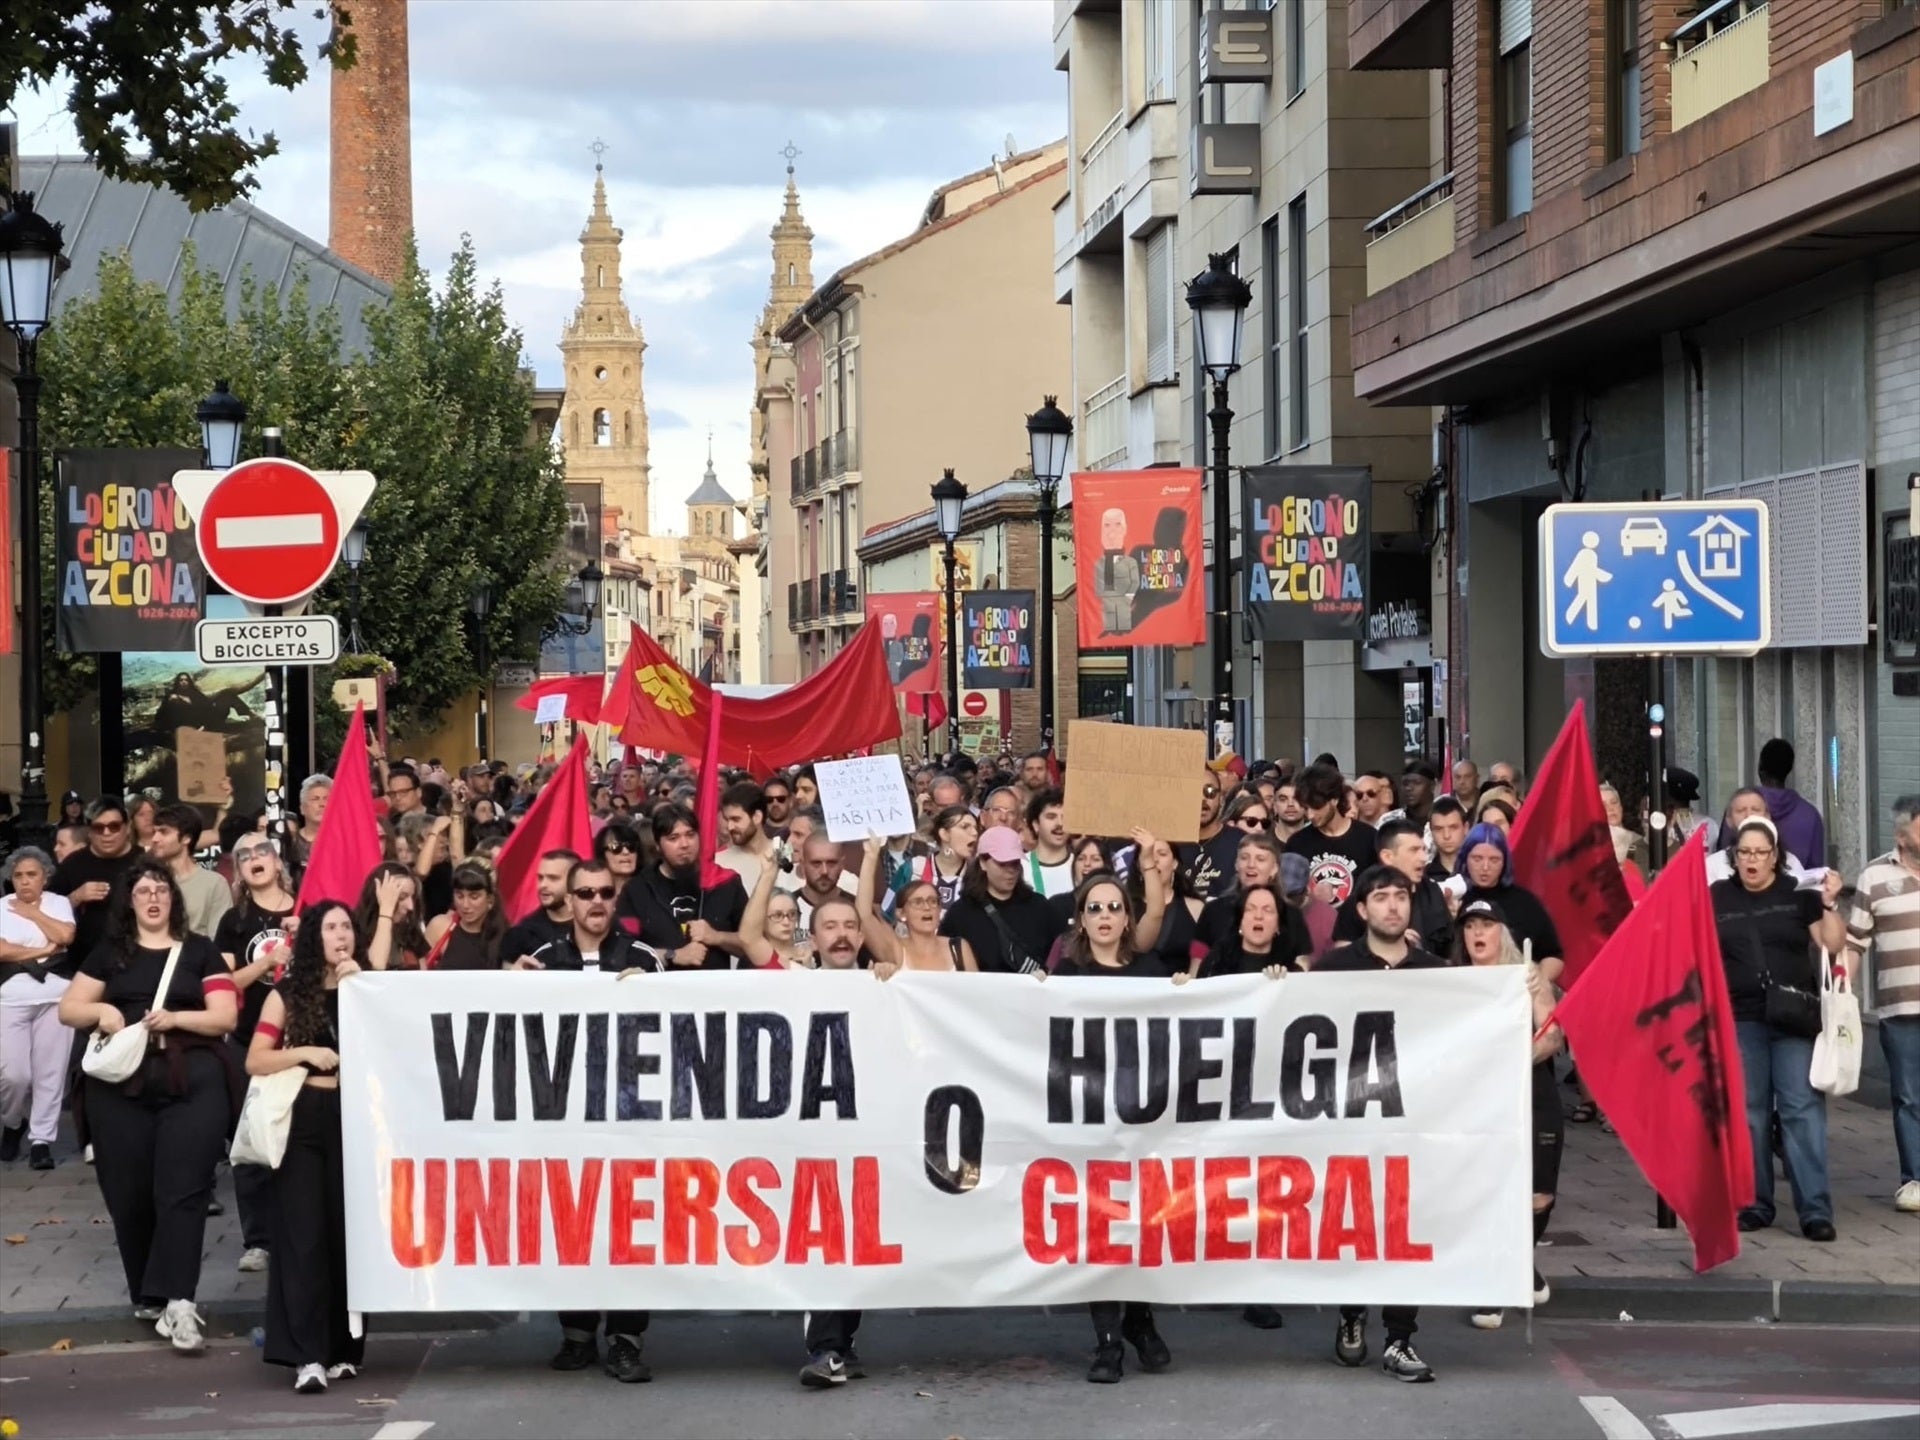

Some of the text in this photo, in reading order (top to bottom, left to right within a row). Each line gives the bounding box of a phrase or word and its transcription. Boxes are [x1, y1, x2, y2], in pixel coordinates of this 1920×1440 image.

[68, 482, 190, 534] LOGROÑO
[1254, 494, 1359, 538] LOGROÑO
[63, 557, 197, 606] AZCONA
[1141, 573, 1183, 590] AZCONA
[1250, 559, 1363, 602] AZCONA
[226, 625, 308, 640] EXCEPTO
[968, 605, 1028, 631] LOGROÑO
[215, 643, 320, 658] BICICLETAS
[967, 644, 1030, 668] AZCONA
[827, 806, 903, 826] HABITA
[430, 1010, 1406, 1124] VIVIENDA HUELGA
[924, 1085, 984, 1195] O
[390, 1155, 1434, 1269] UNIVERSAL GENERAL
